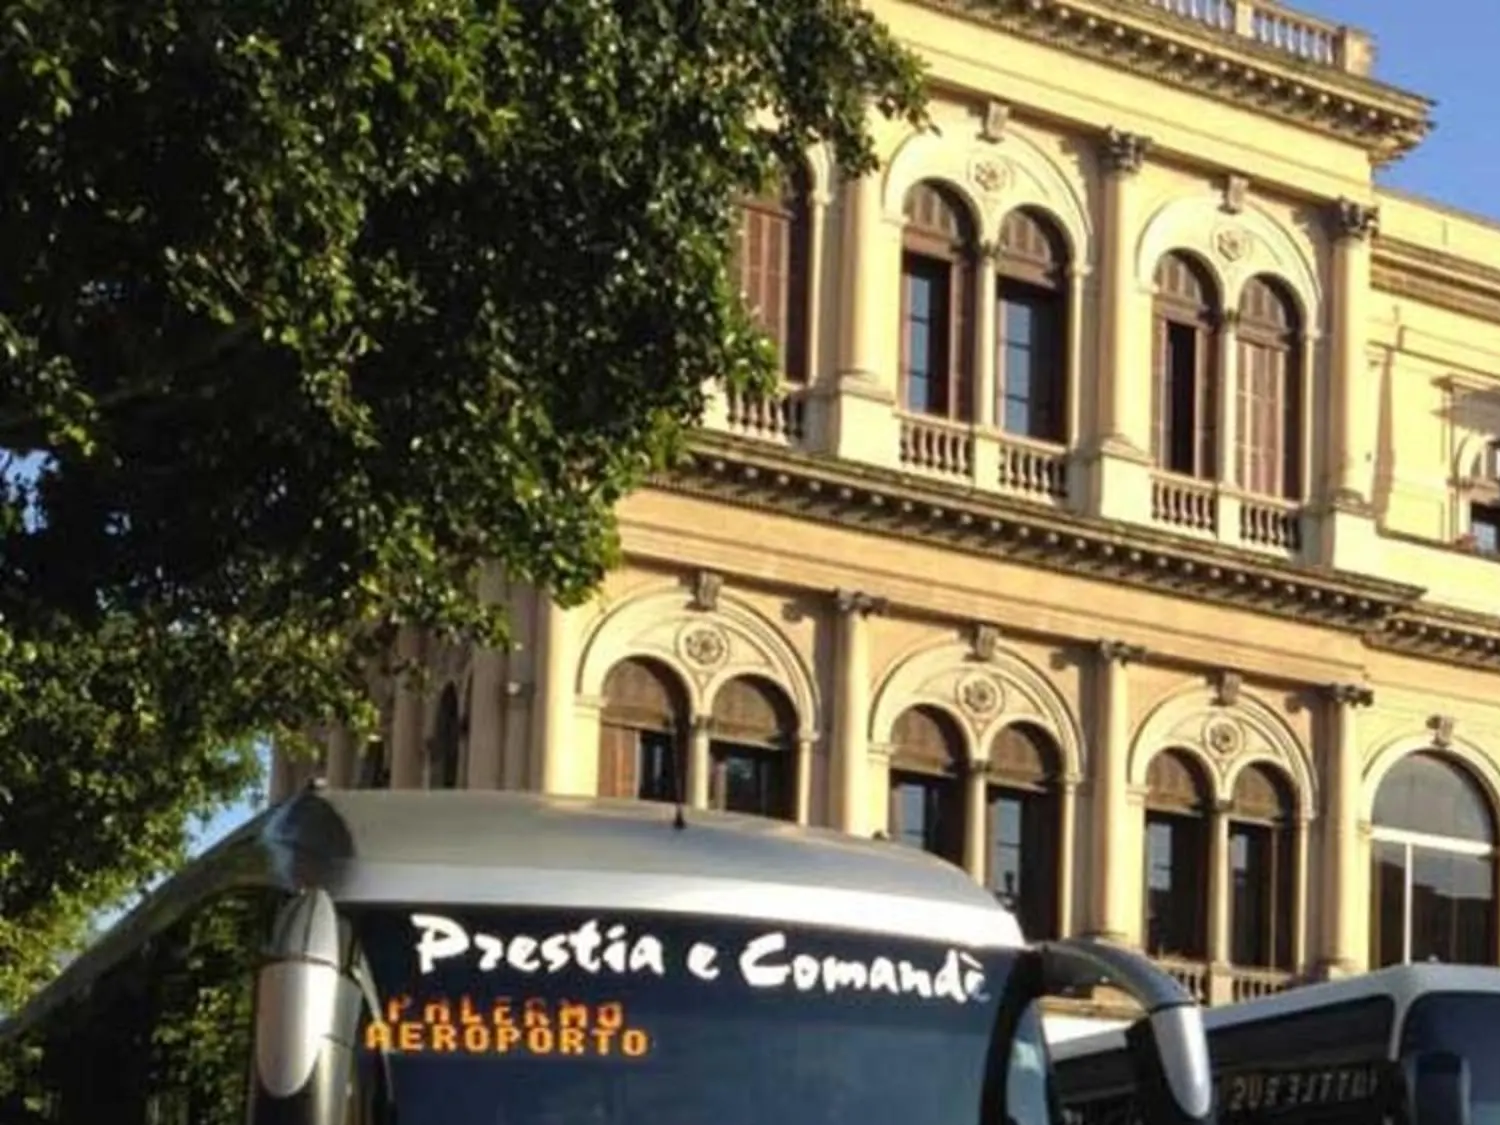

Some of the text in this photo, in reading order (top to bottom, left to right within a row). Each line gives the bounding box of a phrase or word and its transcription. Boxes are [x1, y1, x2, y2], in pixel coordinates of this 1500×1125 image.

[411, 913, 991, 1002] Prestia e Comandè
[364, 1020, 650, 1057] AEROPORTO
